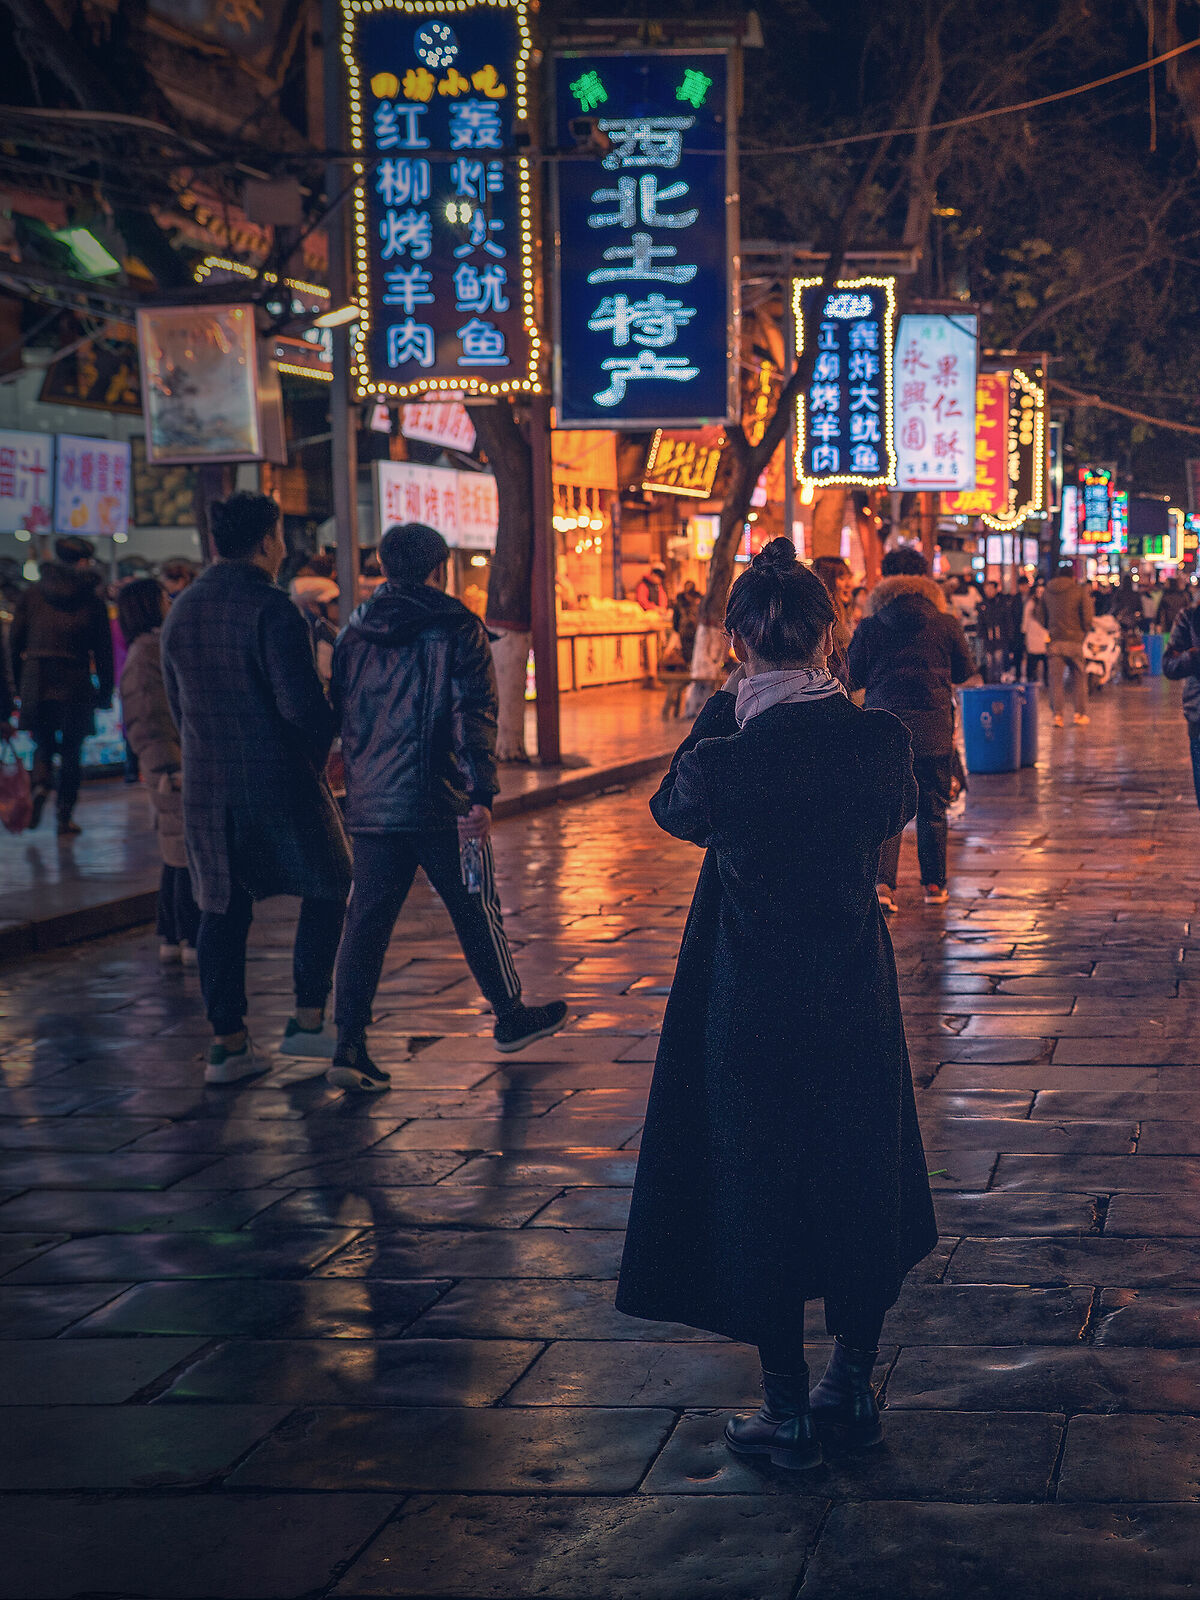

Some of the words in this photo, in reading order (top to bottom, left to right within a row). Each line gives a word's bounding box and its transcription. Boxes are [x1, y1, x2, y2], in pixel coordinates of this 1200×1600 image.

[373, 100, 436, 368] 红柳烤羊肉
[587, 115, 700, 407] 西北土特产
[848, 319, 882, 473] 轰炸大鱿鱼
[932, 354, 964, 461] 果仁酥
